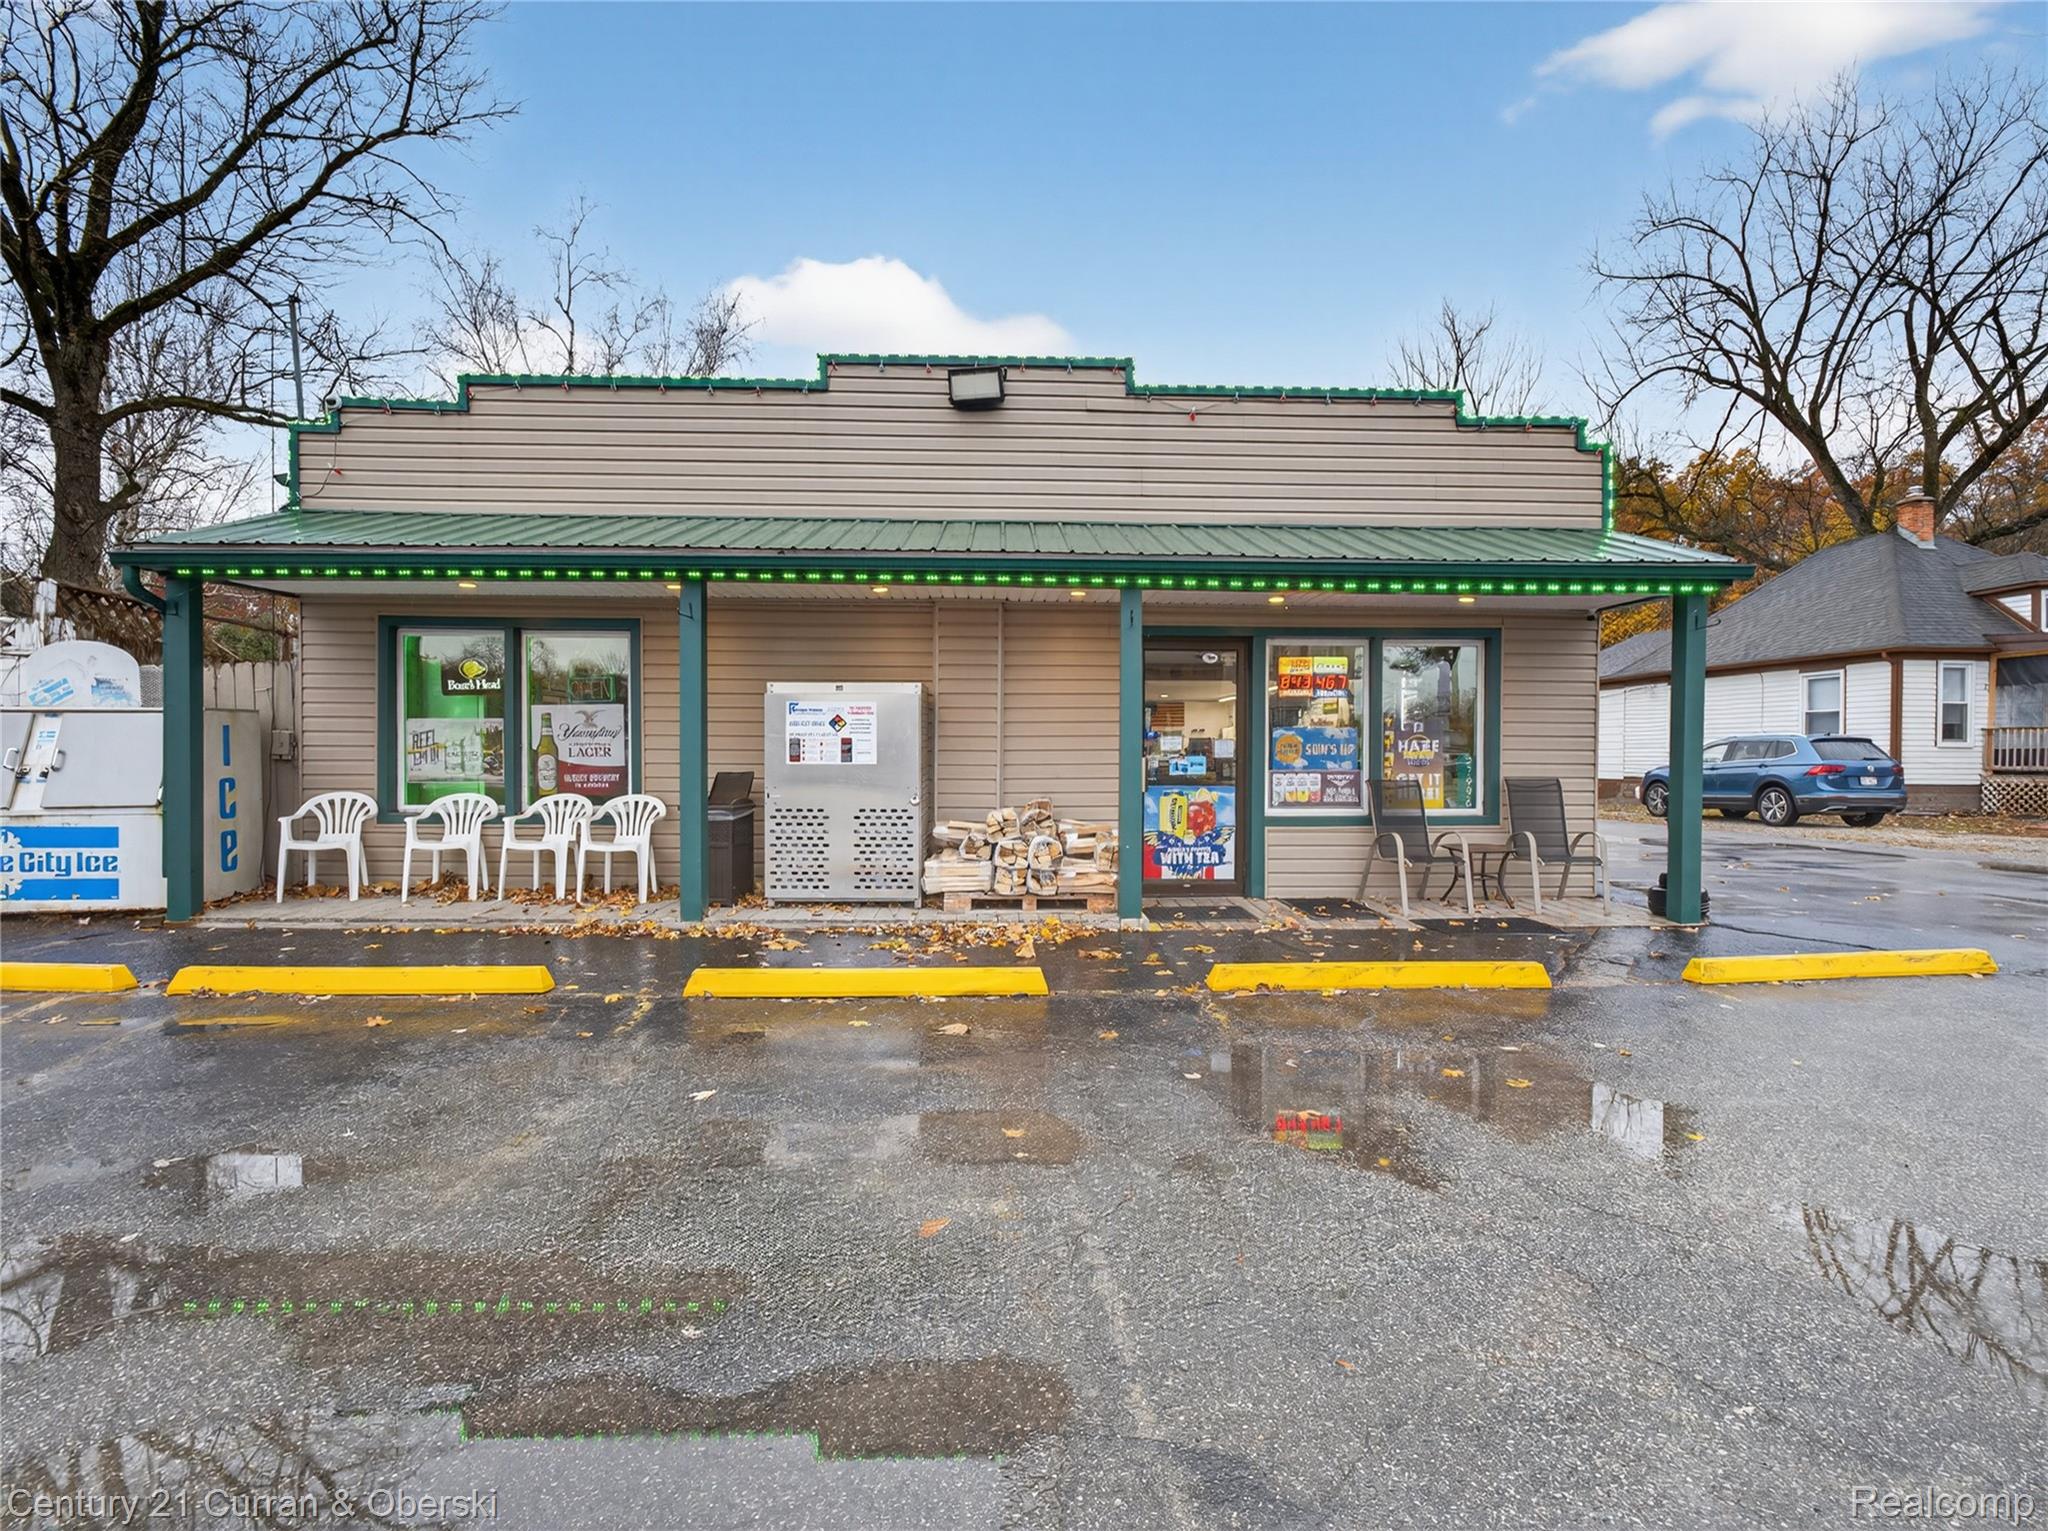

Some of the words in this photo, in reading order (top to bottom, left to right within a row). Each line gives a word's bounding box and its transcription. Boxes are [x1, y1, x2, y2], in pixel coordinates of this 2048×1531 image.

[448, 679, 475, 691] Boar's
[476, 679, 501, 691] Head
[568, 746, 613, 758] LAGER
[19, 852, 72, 877] City
[76, 852, 118, 873] Ice
[1160, 851, 1193, 865] WITH
